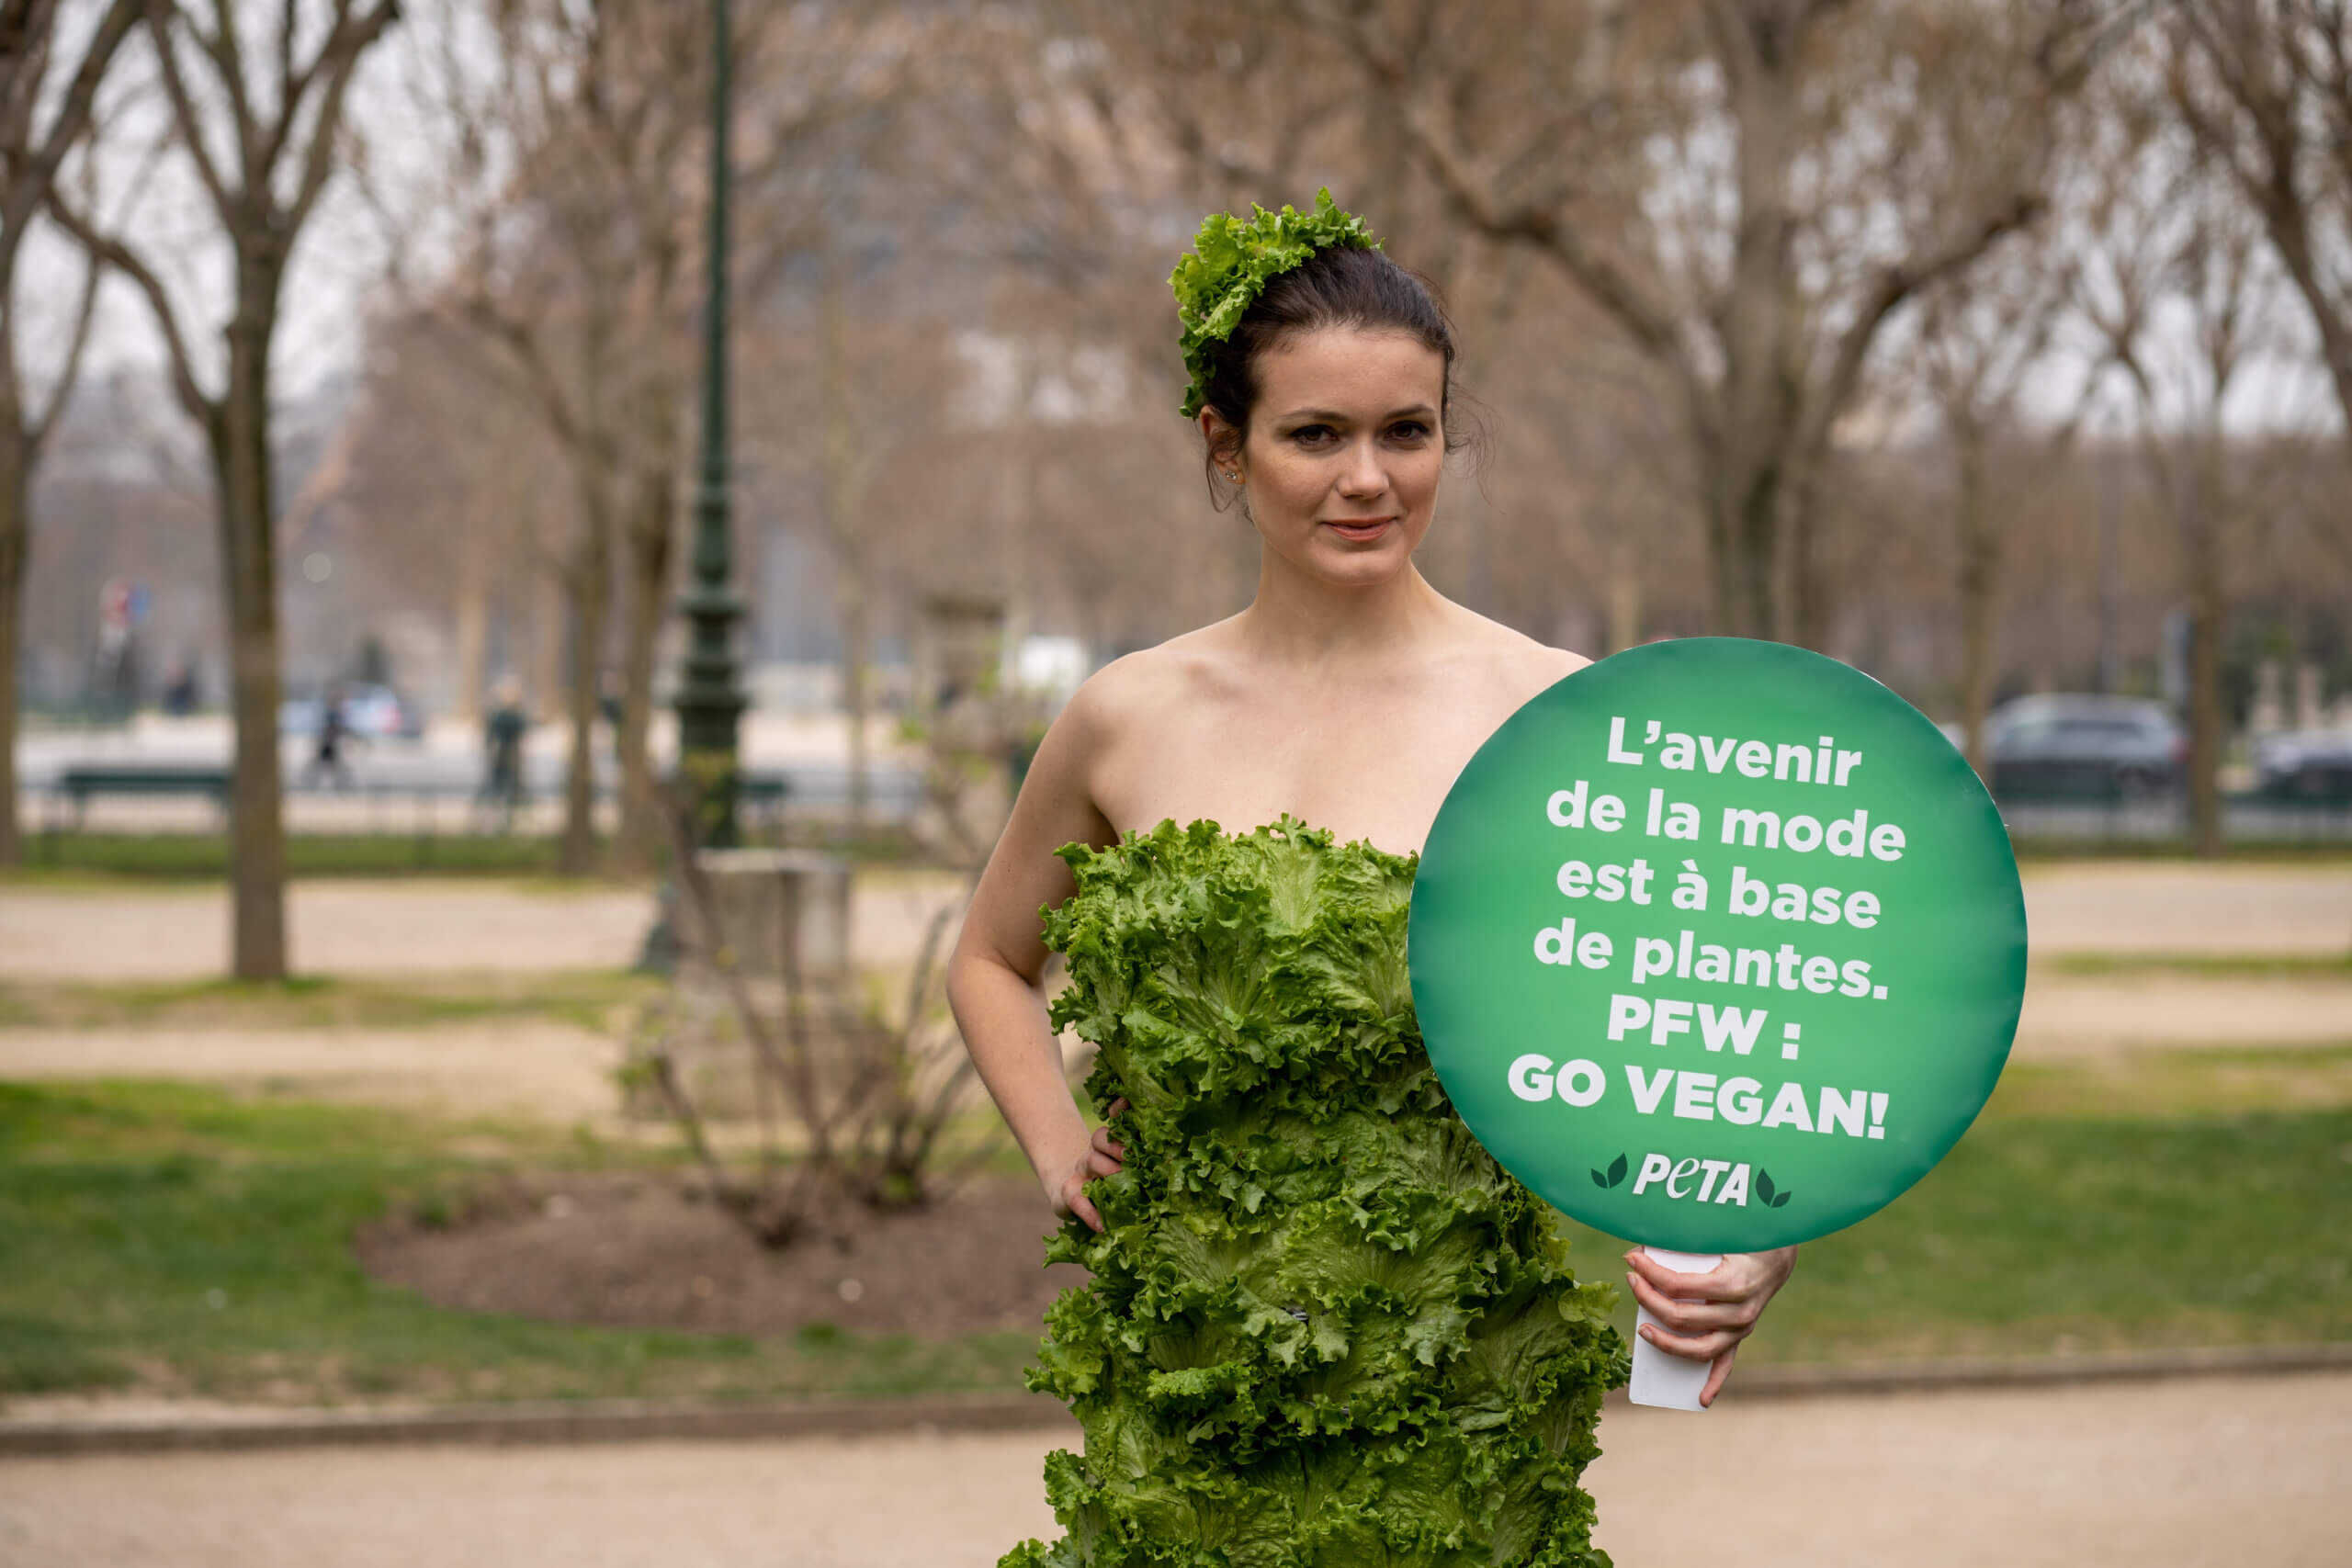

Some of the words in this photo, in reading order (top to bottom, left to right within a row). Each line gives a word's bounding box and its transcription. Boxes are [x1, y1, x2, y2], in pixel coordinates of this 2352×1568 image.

[1608, 716, 1861, 786] L’avenir
[1546, 780, 1626, 832] de
[1646, 788, 1700, 840] la
[1721, 808, 1906, 861] mode
[1556, 859, 1654, 905] est
[1672, 859, 1708, 910] à
[1728, 866, 1881, 929] base
[1533, 918, 1613, 969] de
[1632, 930, 1888, 1000] plantes.
[1607, 994, 1768, 1055] PFW
[1508, 1054, 1606, 1108] GO
[1623, 1066, 1890, 1140] VEGAN!
